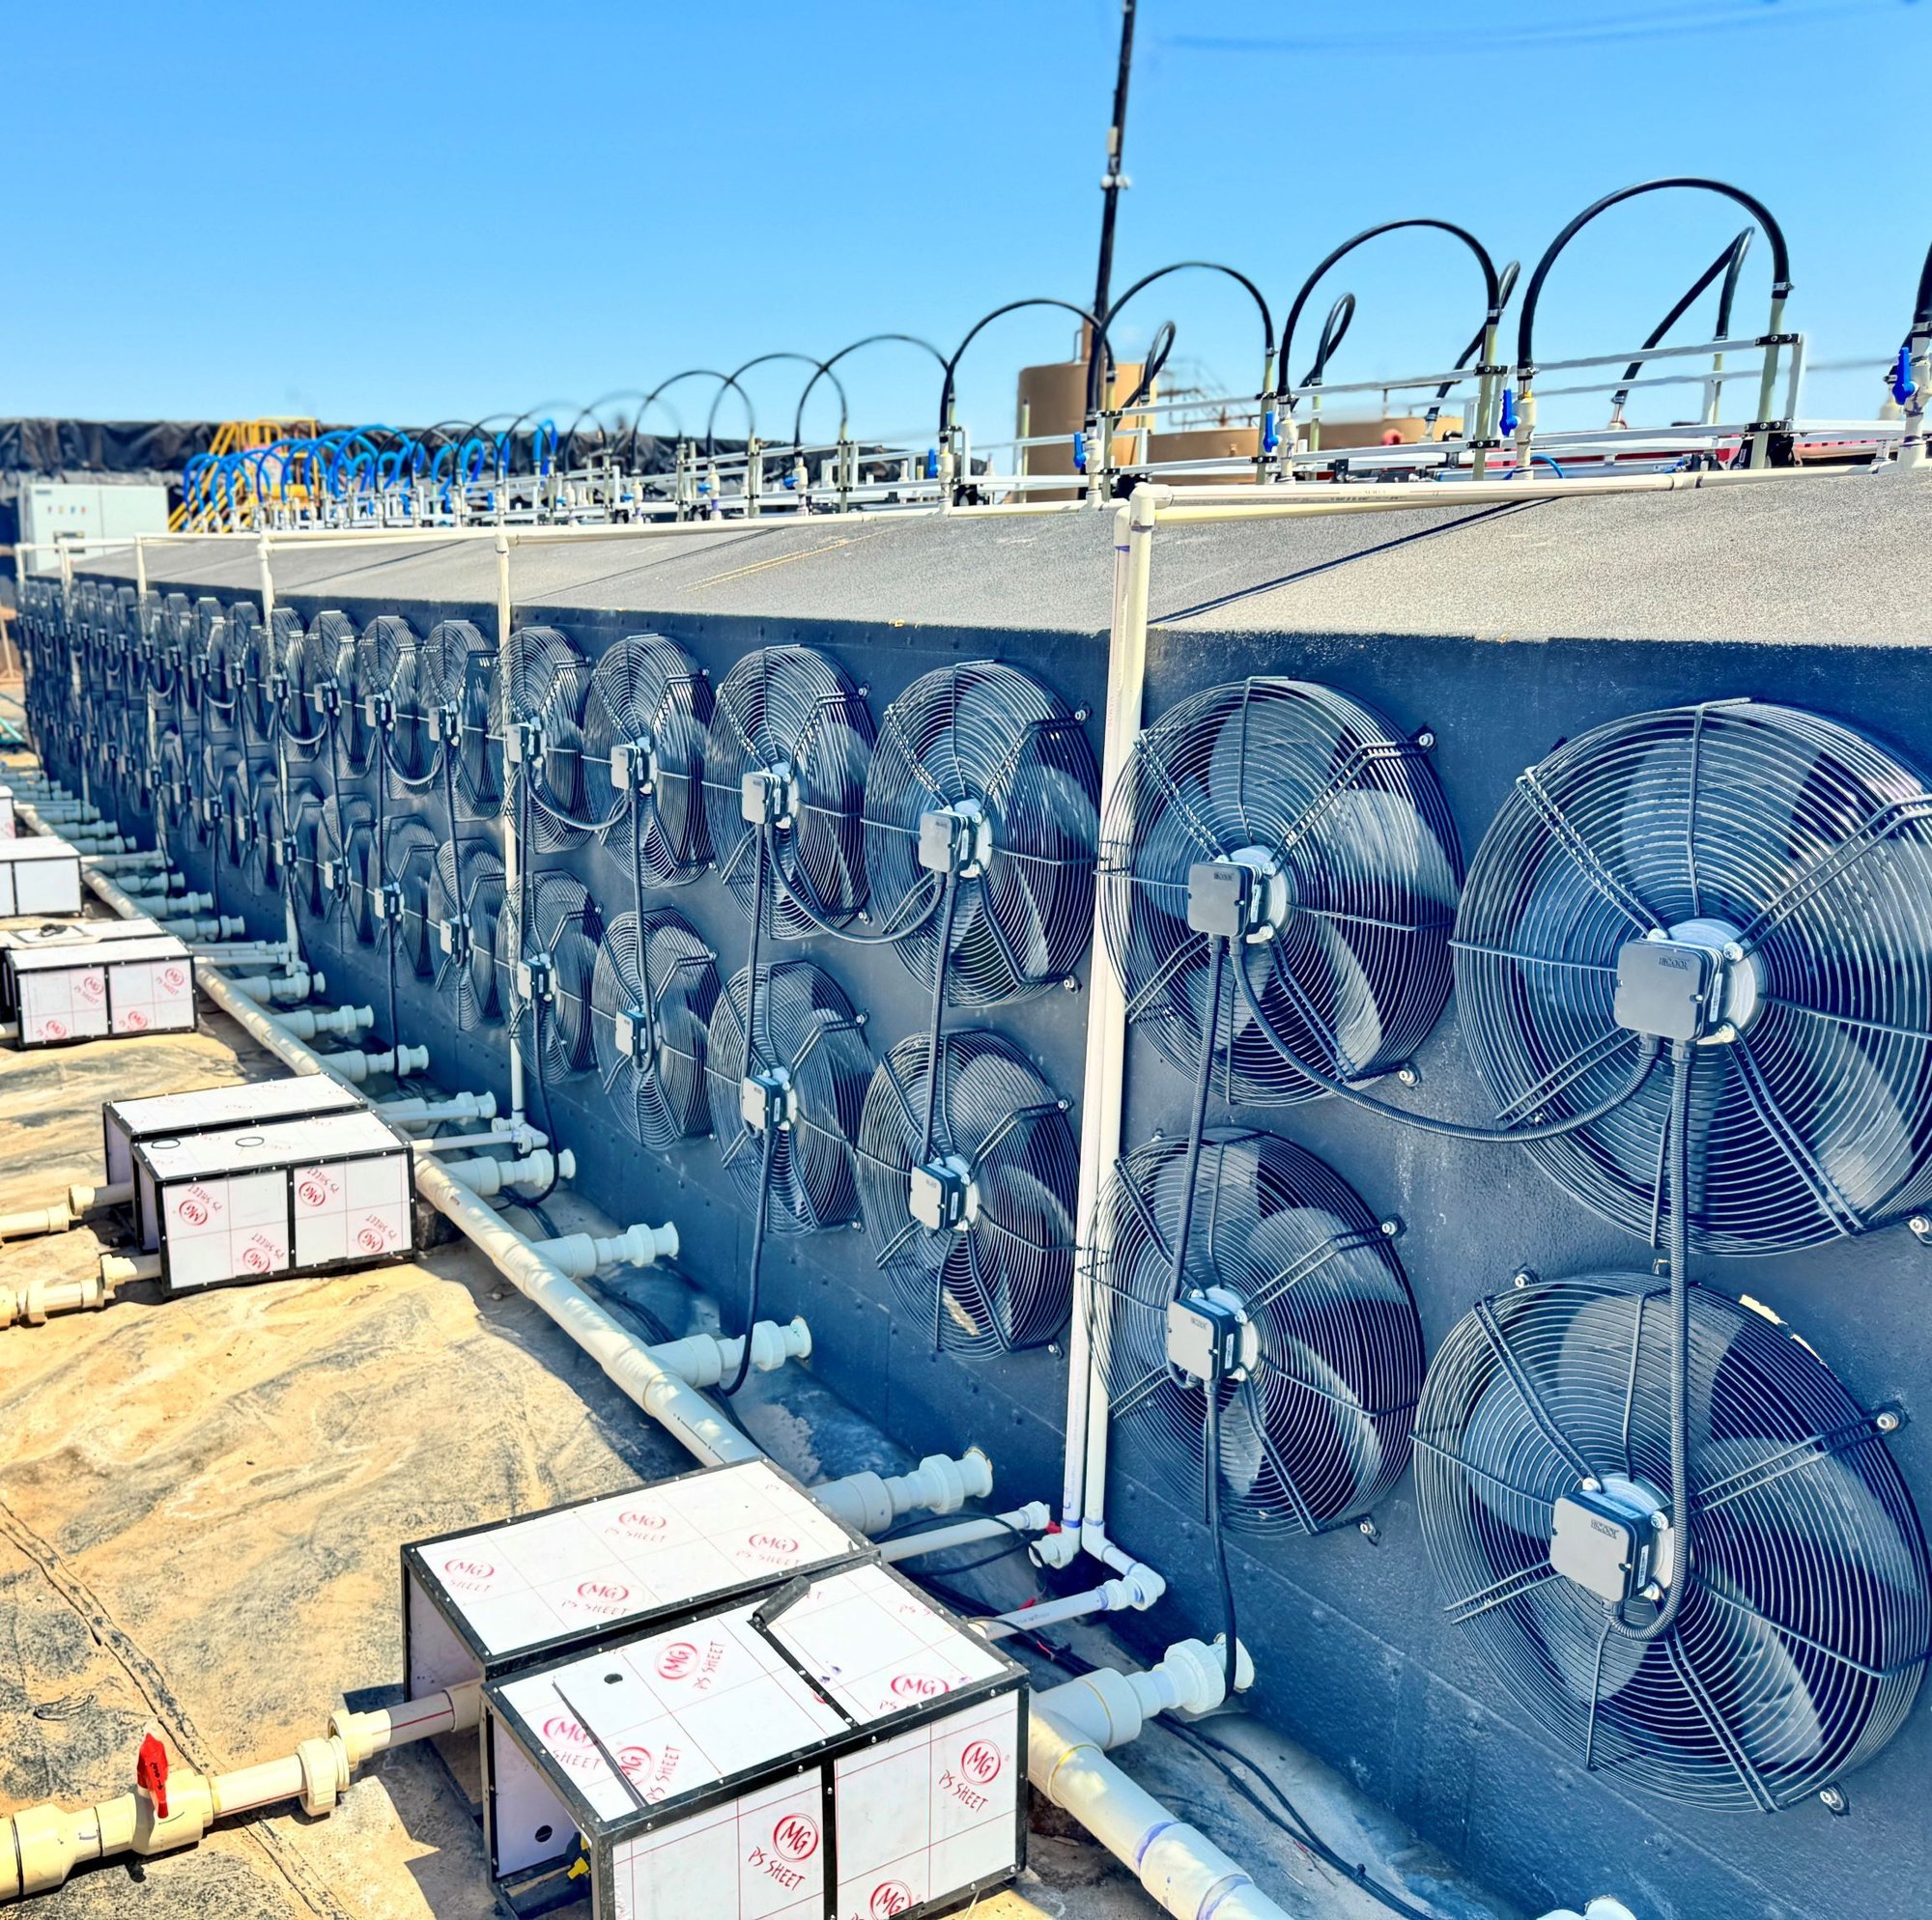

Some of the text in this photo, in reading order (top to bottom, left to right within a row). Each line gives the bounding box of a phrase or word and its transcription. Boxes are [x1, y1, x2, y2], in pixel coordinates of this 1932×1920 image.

[626, 1531, 667, 1543] SHEET
[758, 1536, 787, 1550] MG
[457, 1560, 485, 1576] MG
[448, 1579, 493, 1593] SHEET
[590, 1583, 618, 1598] MG
[582, 1603, 630, 1616] SHEET
[664, 1650, 691, 1673] MG
[694, 1640, 725, 1690] PS SHEET
[902, 1679, 936, 1695] MG
[552, 1749, 603, 1770] SHEET
[966, 1745, 994, 1775] MG
[646, 1744, 683, 1801] PS SHEET
[938, 1768, 989, 1813] PS SHEET
[780, 1821, 811, 1854] MG
[748, 1846, 807, 1892] PS SHEET
[875, 1887, 905, 1915] MG
